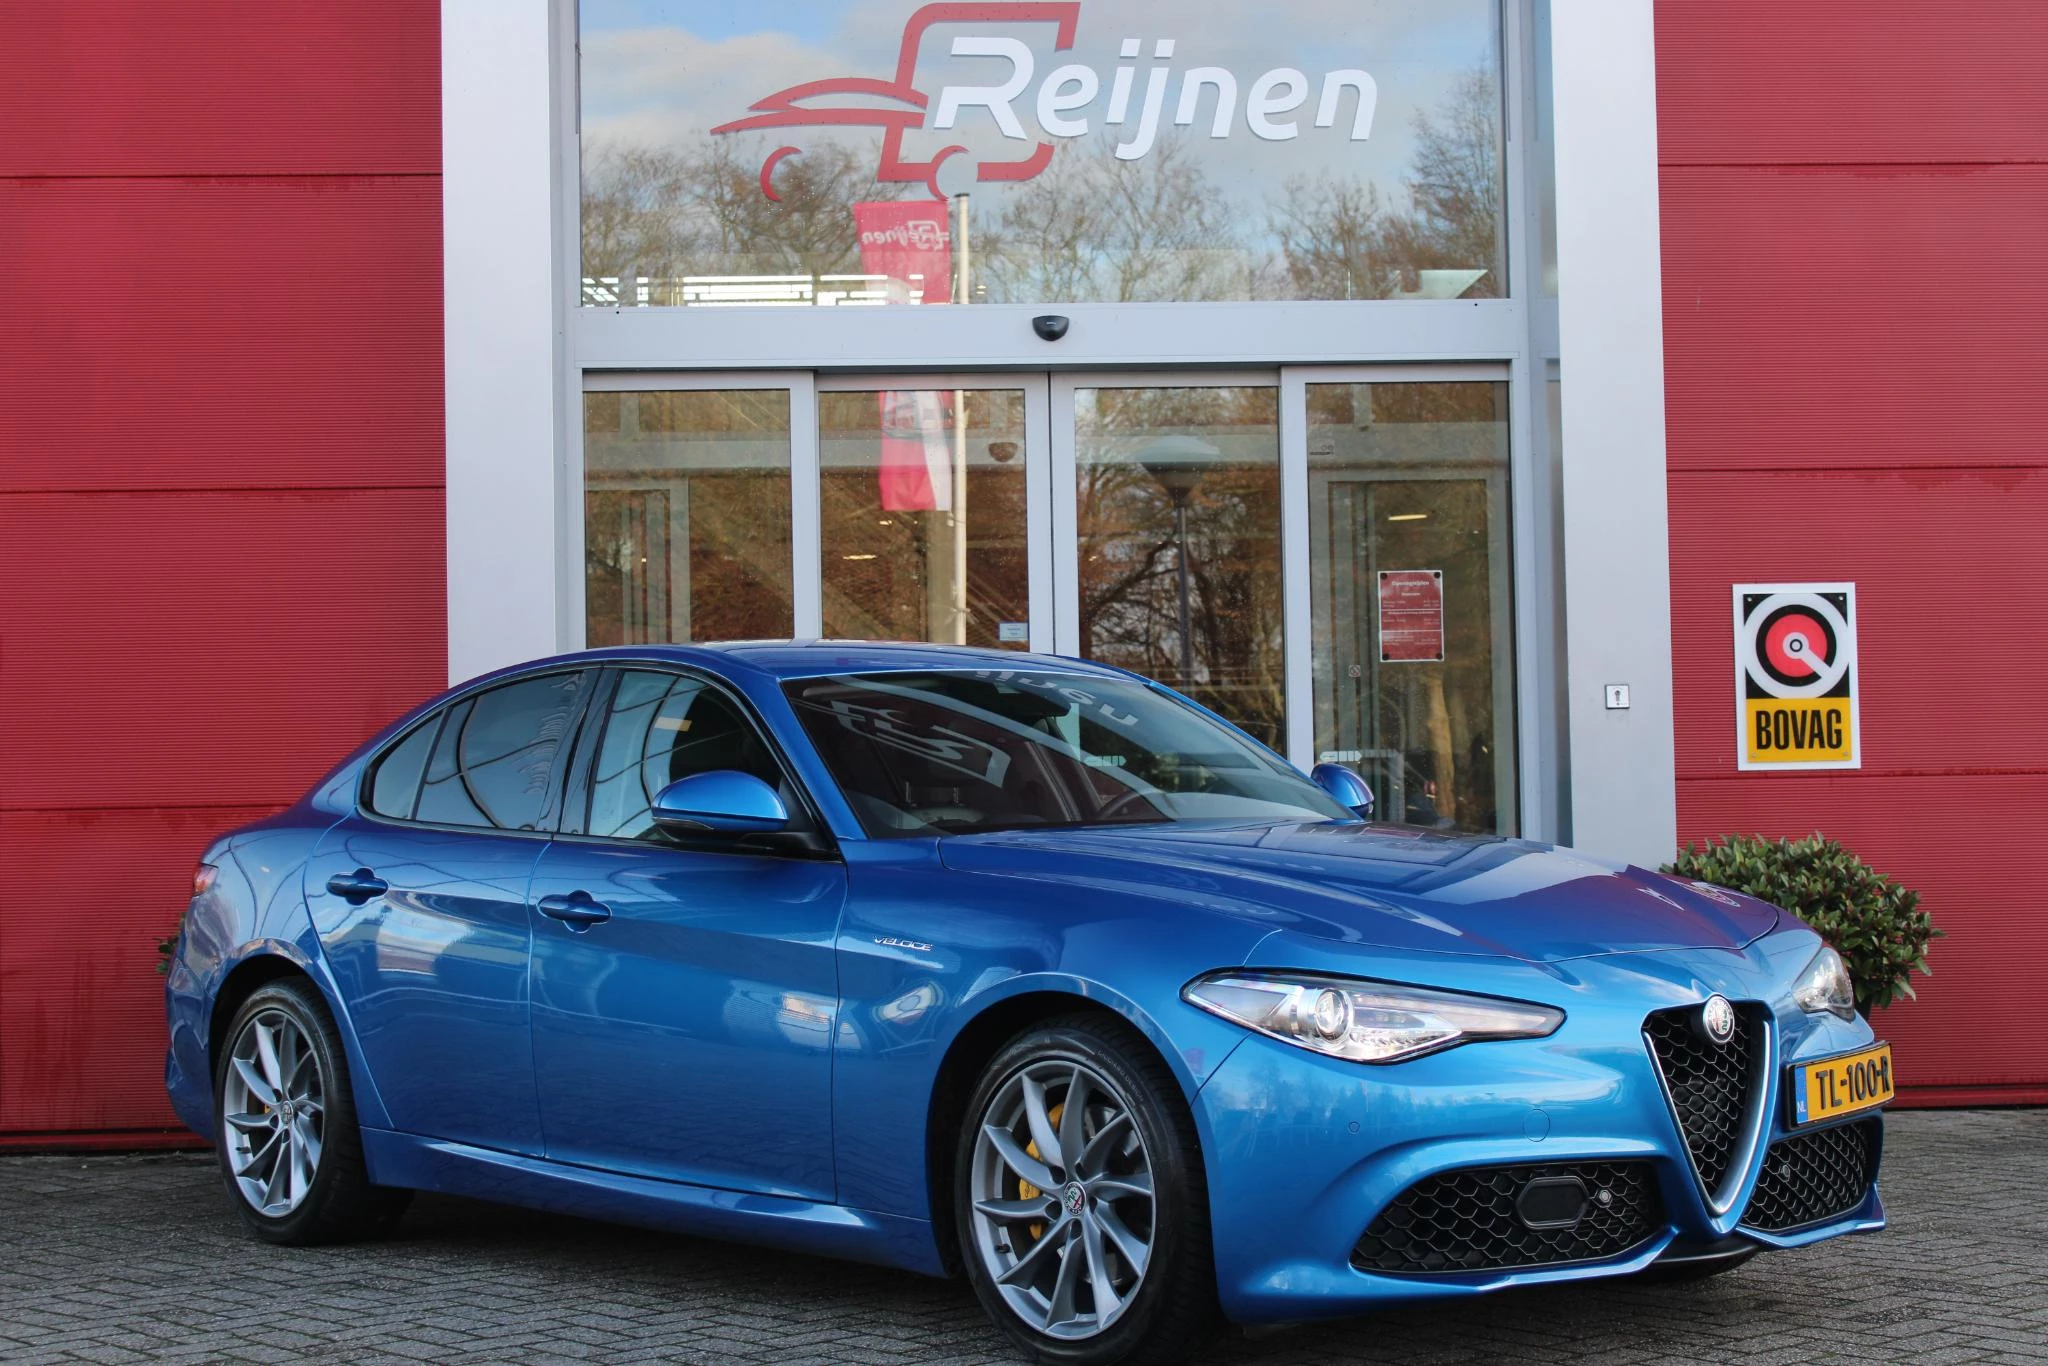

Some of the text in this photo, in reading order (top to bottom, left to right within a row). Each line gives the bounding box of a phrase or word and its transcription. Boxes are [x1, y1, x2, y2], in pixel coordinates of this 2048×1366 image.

[933, 37, 1378, 161] Reijnen
[1755, 708, 1843, 750] BOVAG
[874, 936, 932, 951] VELOCE
[1815, 1055, 1890, 1110] TL-100-R
